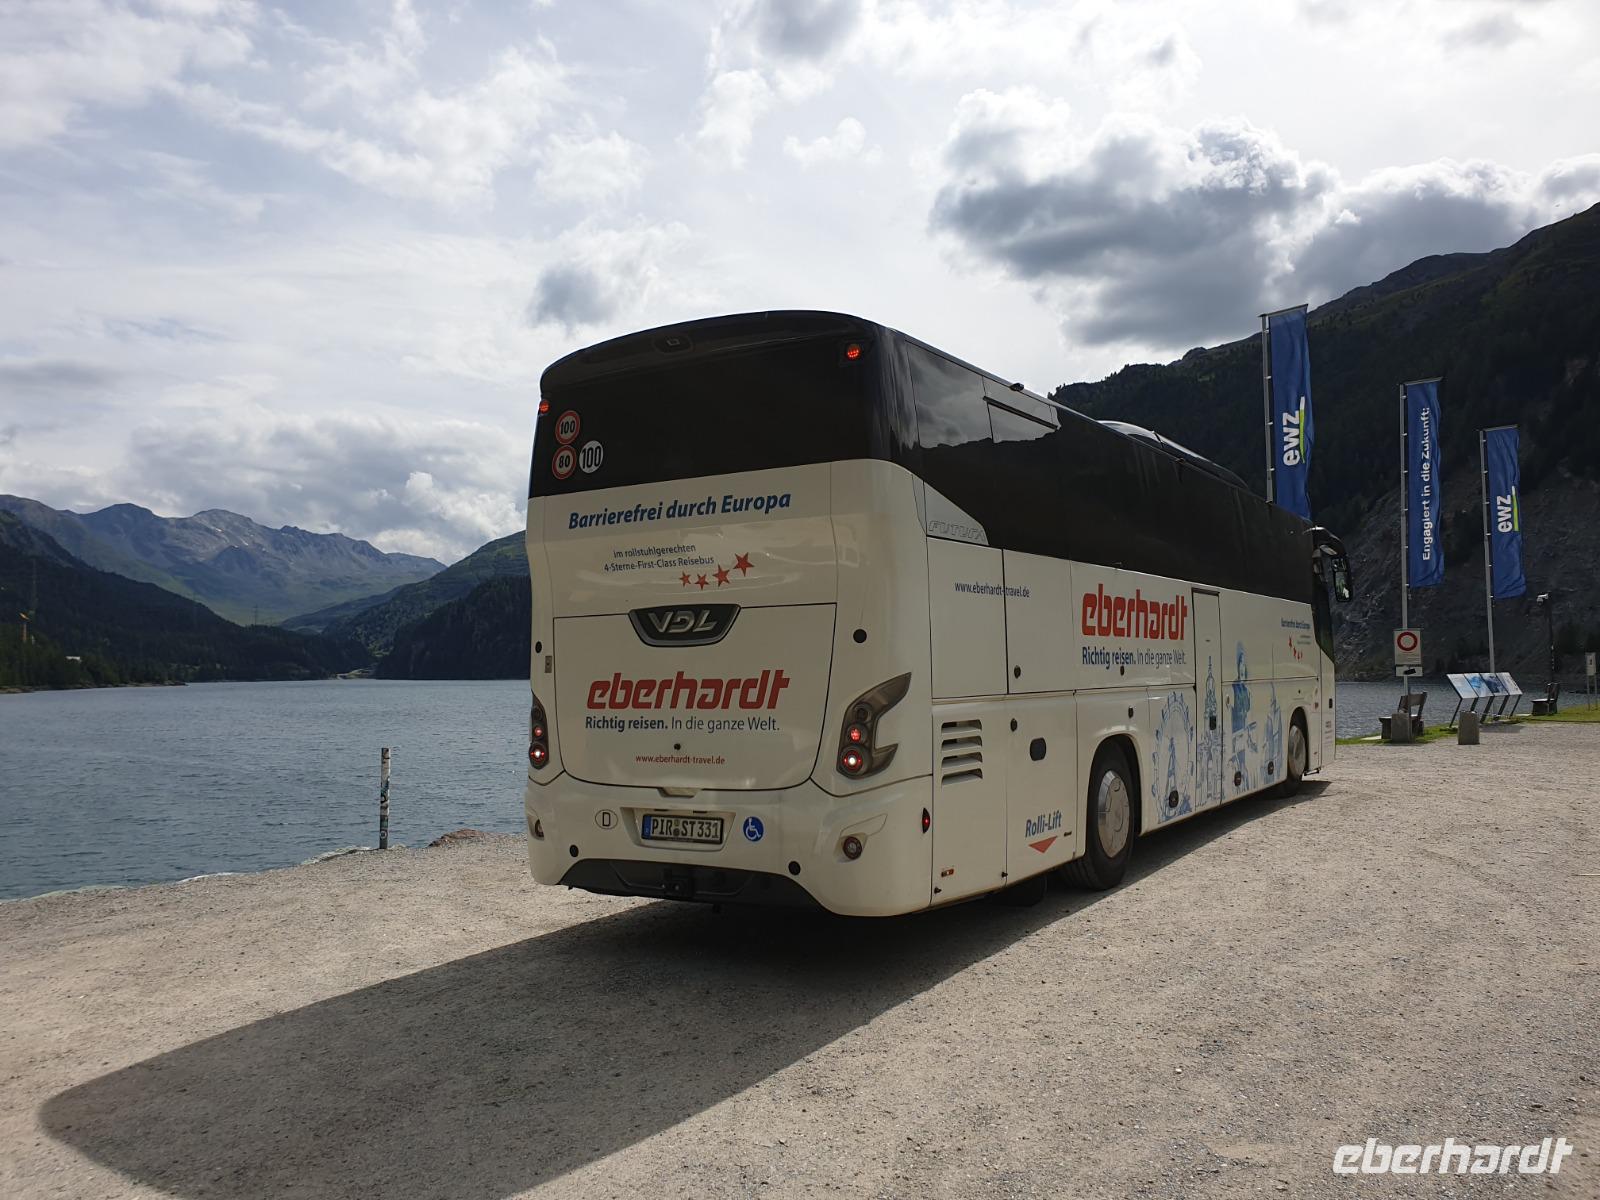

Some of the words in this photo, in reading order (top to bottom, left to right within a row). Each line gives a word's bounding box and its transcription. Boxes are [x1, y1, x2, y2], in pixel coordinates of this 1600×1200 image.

[560, 420, 576, 435] 100
[1282, 410, 1301, 466] ewz
[558, 455, 571, 469] 80
[581, 445, 602, 470] 100
[1420, 462, 1430, 482] die
[1421, 485, 1431, 497] in
[568, 501, 663, 530] Barrierefrei
[665, 496, 718, 519] durch
[720, 493, 792, 515] Europa
[1497, 494, 1513, 533] ewz
[1422, 500, 1433, 560] Engagiert
[677, 555, 715, 567] Reisebus
[954, 581, 1031, 598] www.eberhardt-travel.de
[647, 610, 719, 633] VDL
[1081, 583, 1188, 641] eberhardt
[1082, 646, 1111, 670] Richtig
[1112, 647, 1137, 665] reisen.
[1136, 649, 1144, 665] In
[1144, 649, 1156, 665] die
[1155, 652, 1174, 669] ganze
[586, 670, 791, 710] eberhardt
[585, 716, 626, 732] Richtig
[628, 716, 669, 730] reisen.
[671, 717, 682, 731] In
[685, 716, 704, 731] die
[707, 719, 745, 733] ganze
[747, 716, 780, 731] Welt.
[635, 754, 726, 765] www.eberhardt-travel.de
[651, 817, 673, 836] PIR
[1025, 810, 1062, 837] Rolli-Lift
